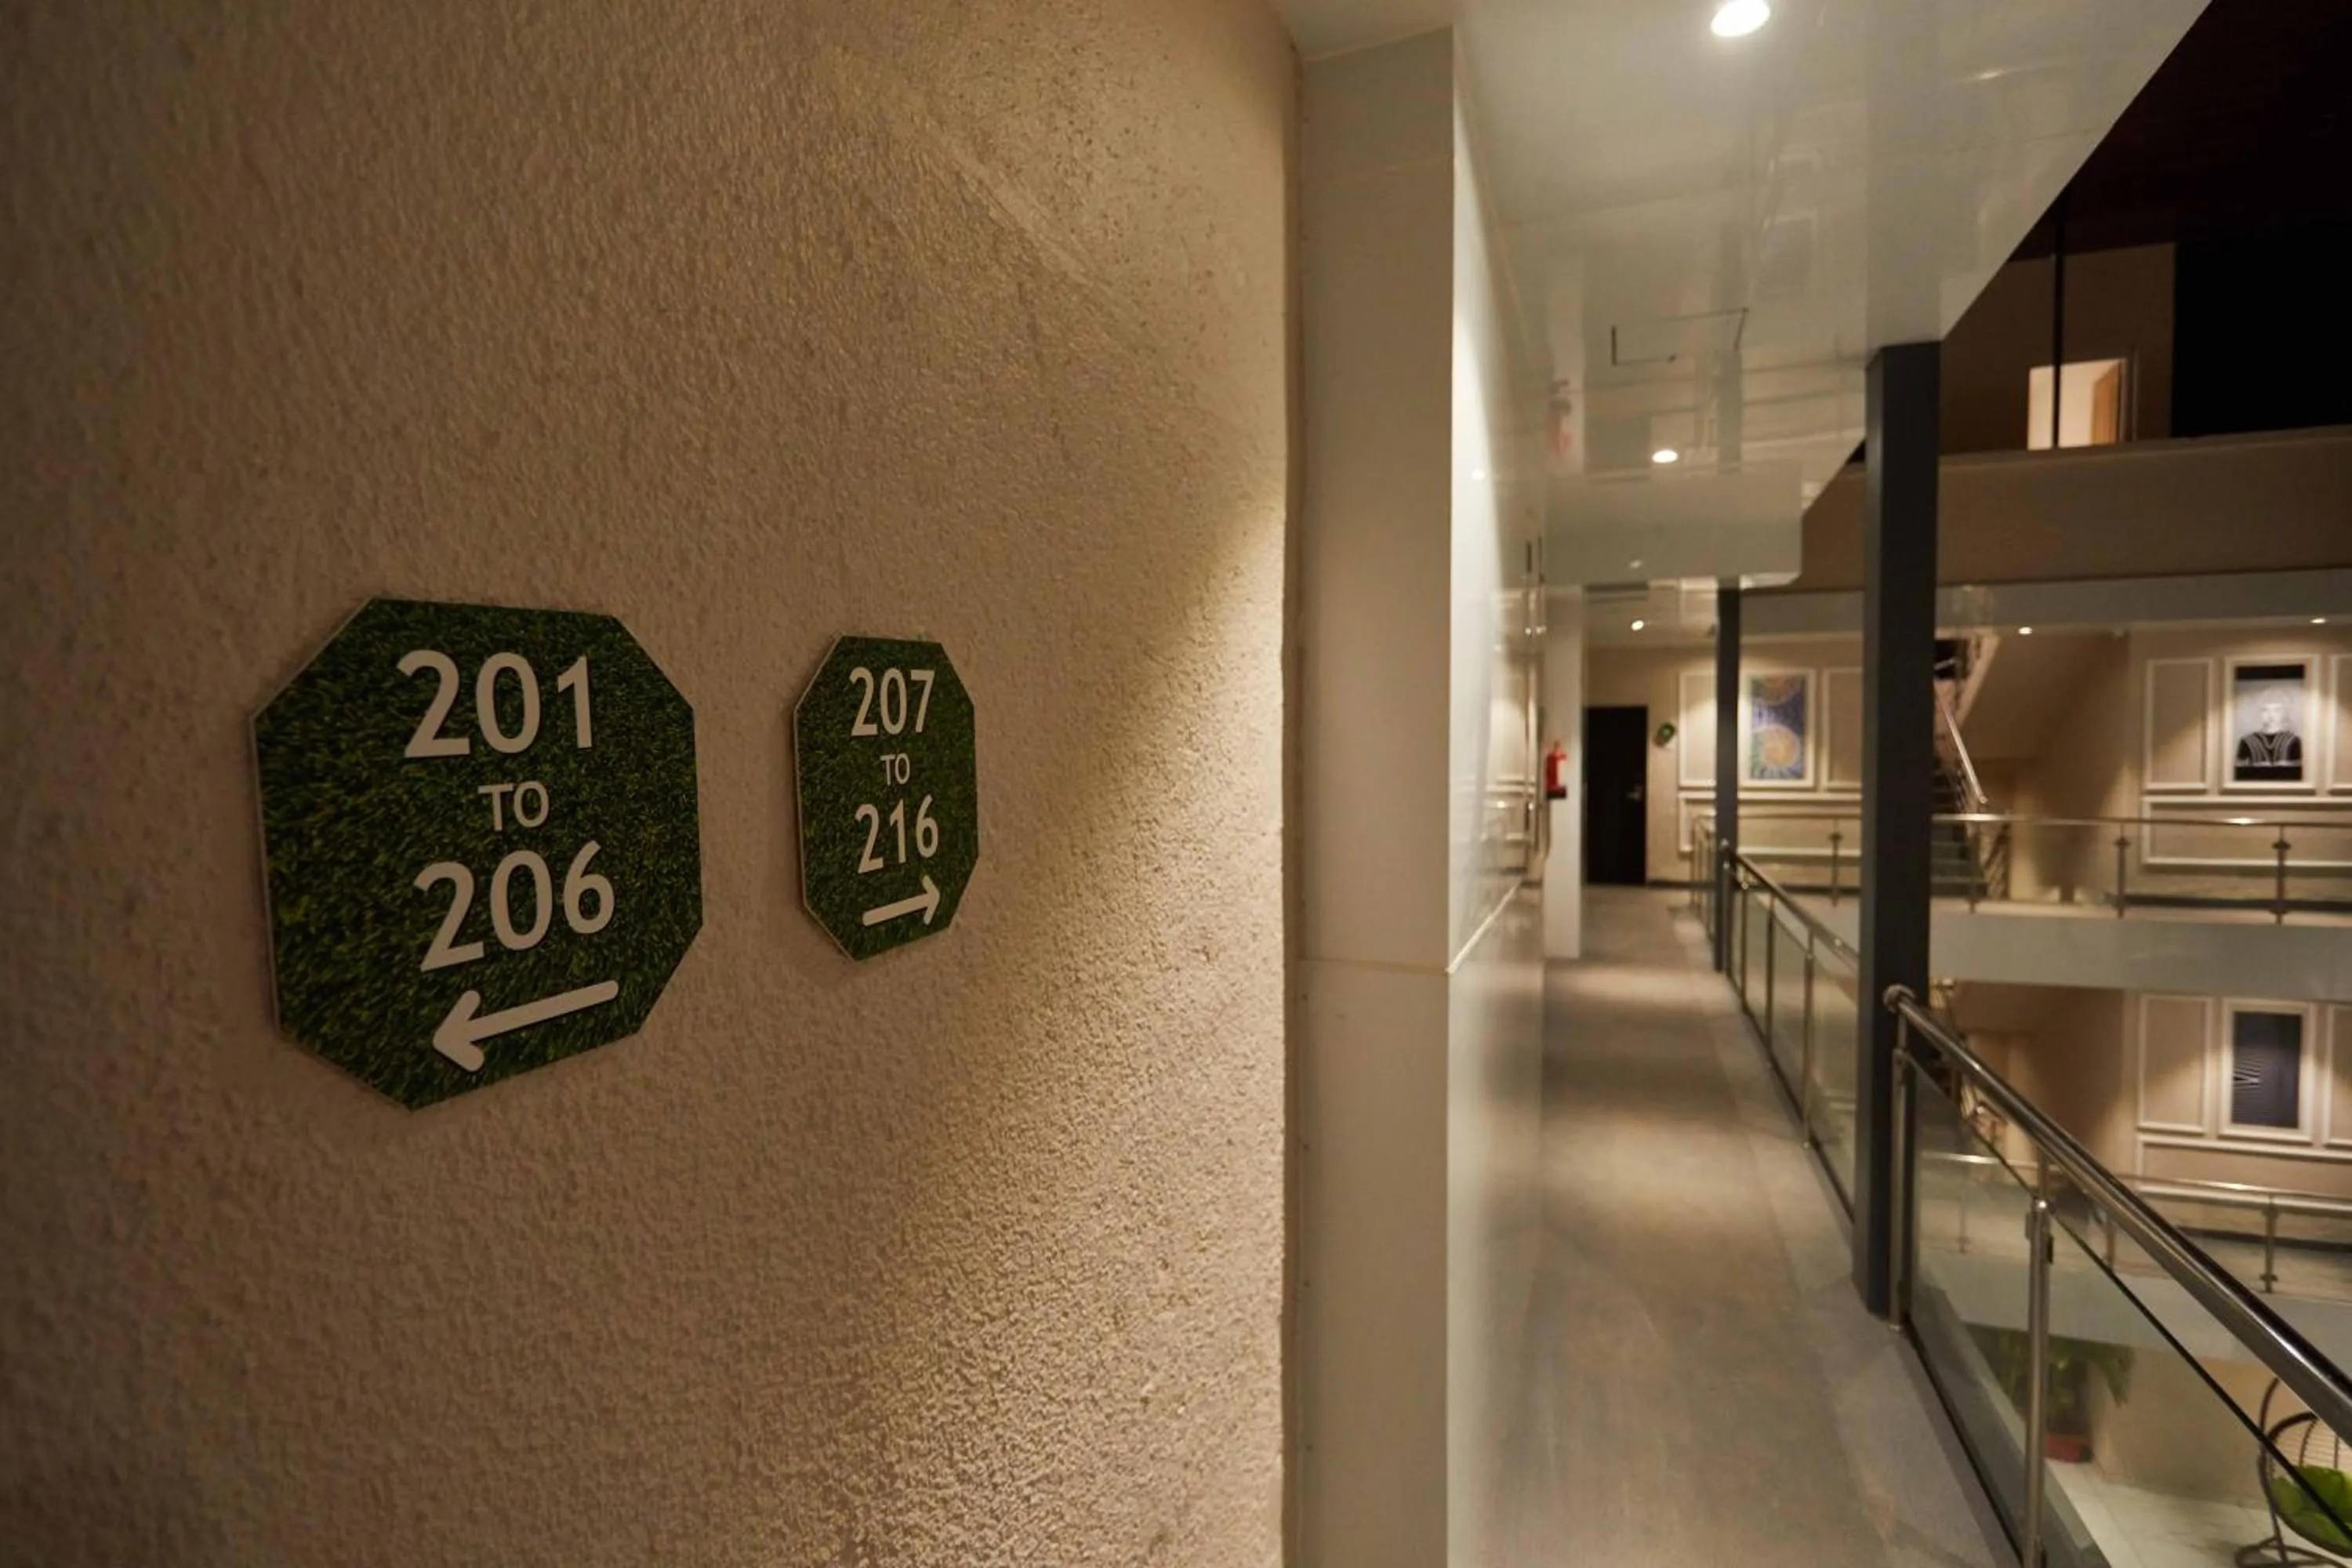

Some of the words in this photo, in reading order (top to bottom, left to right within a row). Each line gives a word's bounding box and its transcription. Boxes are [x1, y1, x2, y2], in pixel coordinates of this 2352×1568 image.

[397, 650, 593, 757] 201
[849, 667, 935, 736] 207
[880, 753, 910, 786] TO
[477, 782, 550, 832] TO
[855, 794, 939, 874] 216
[413, 840, 615, 972] 206
